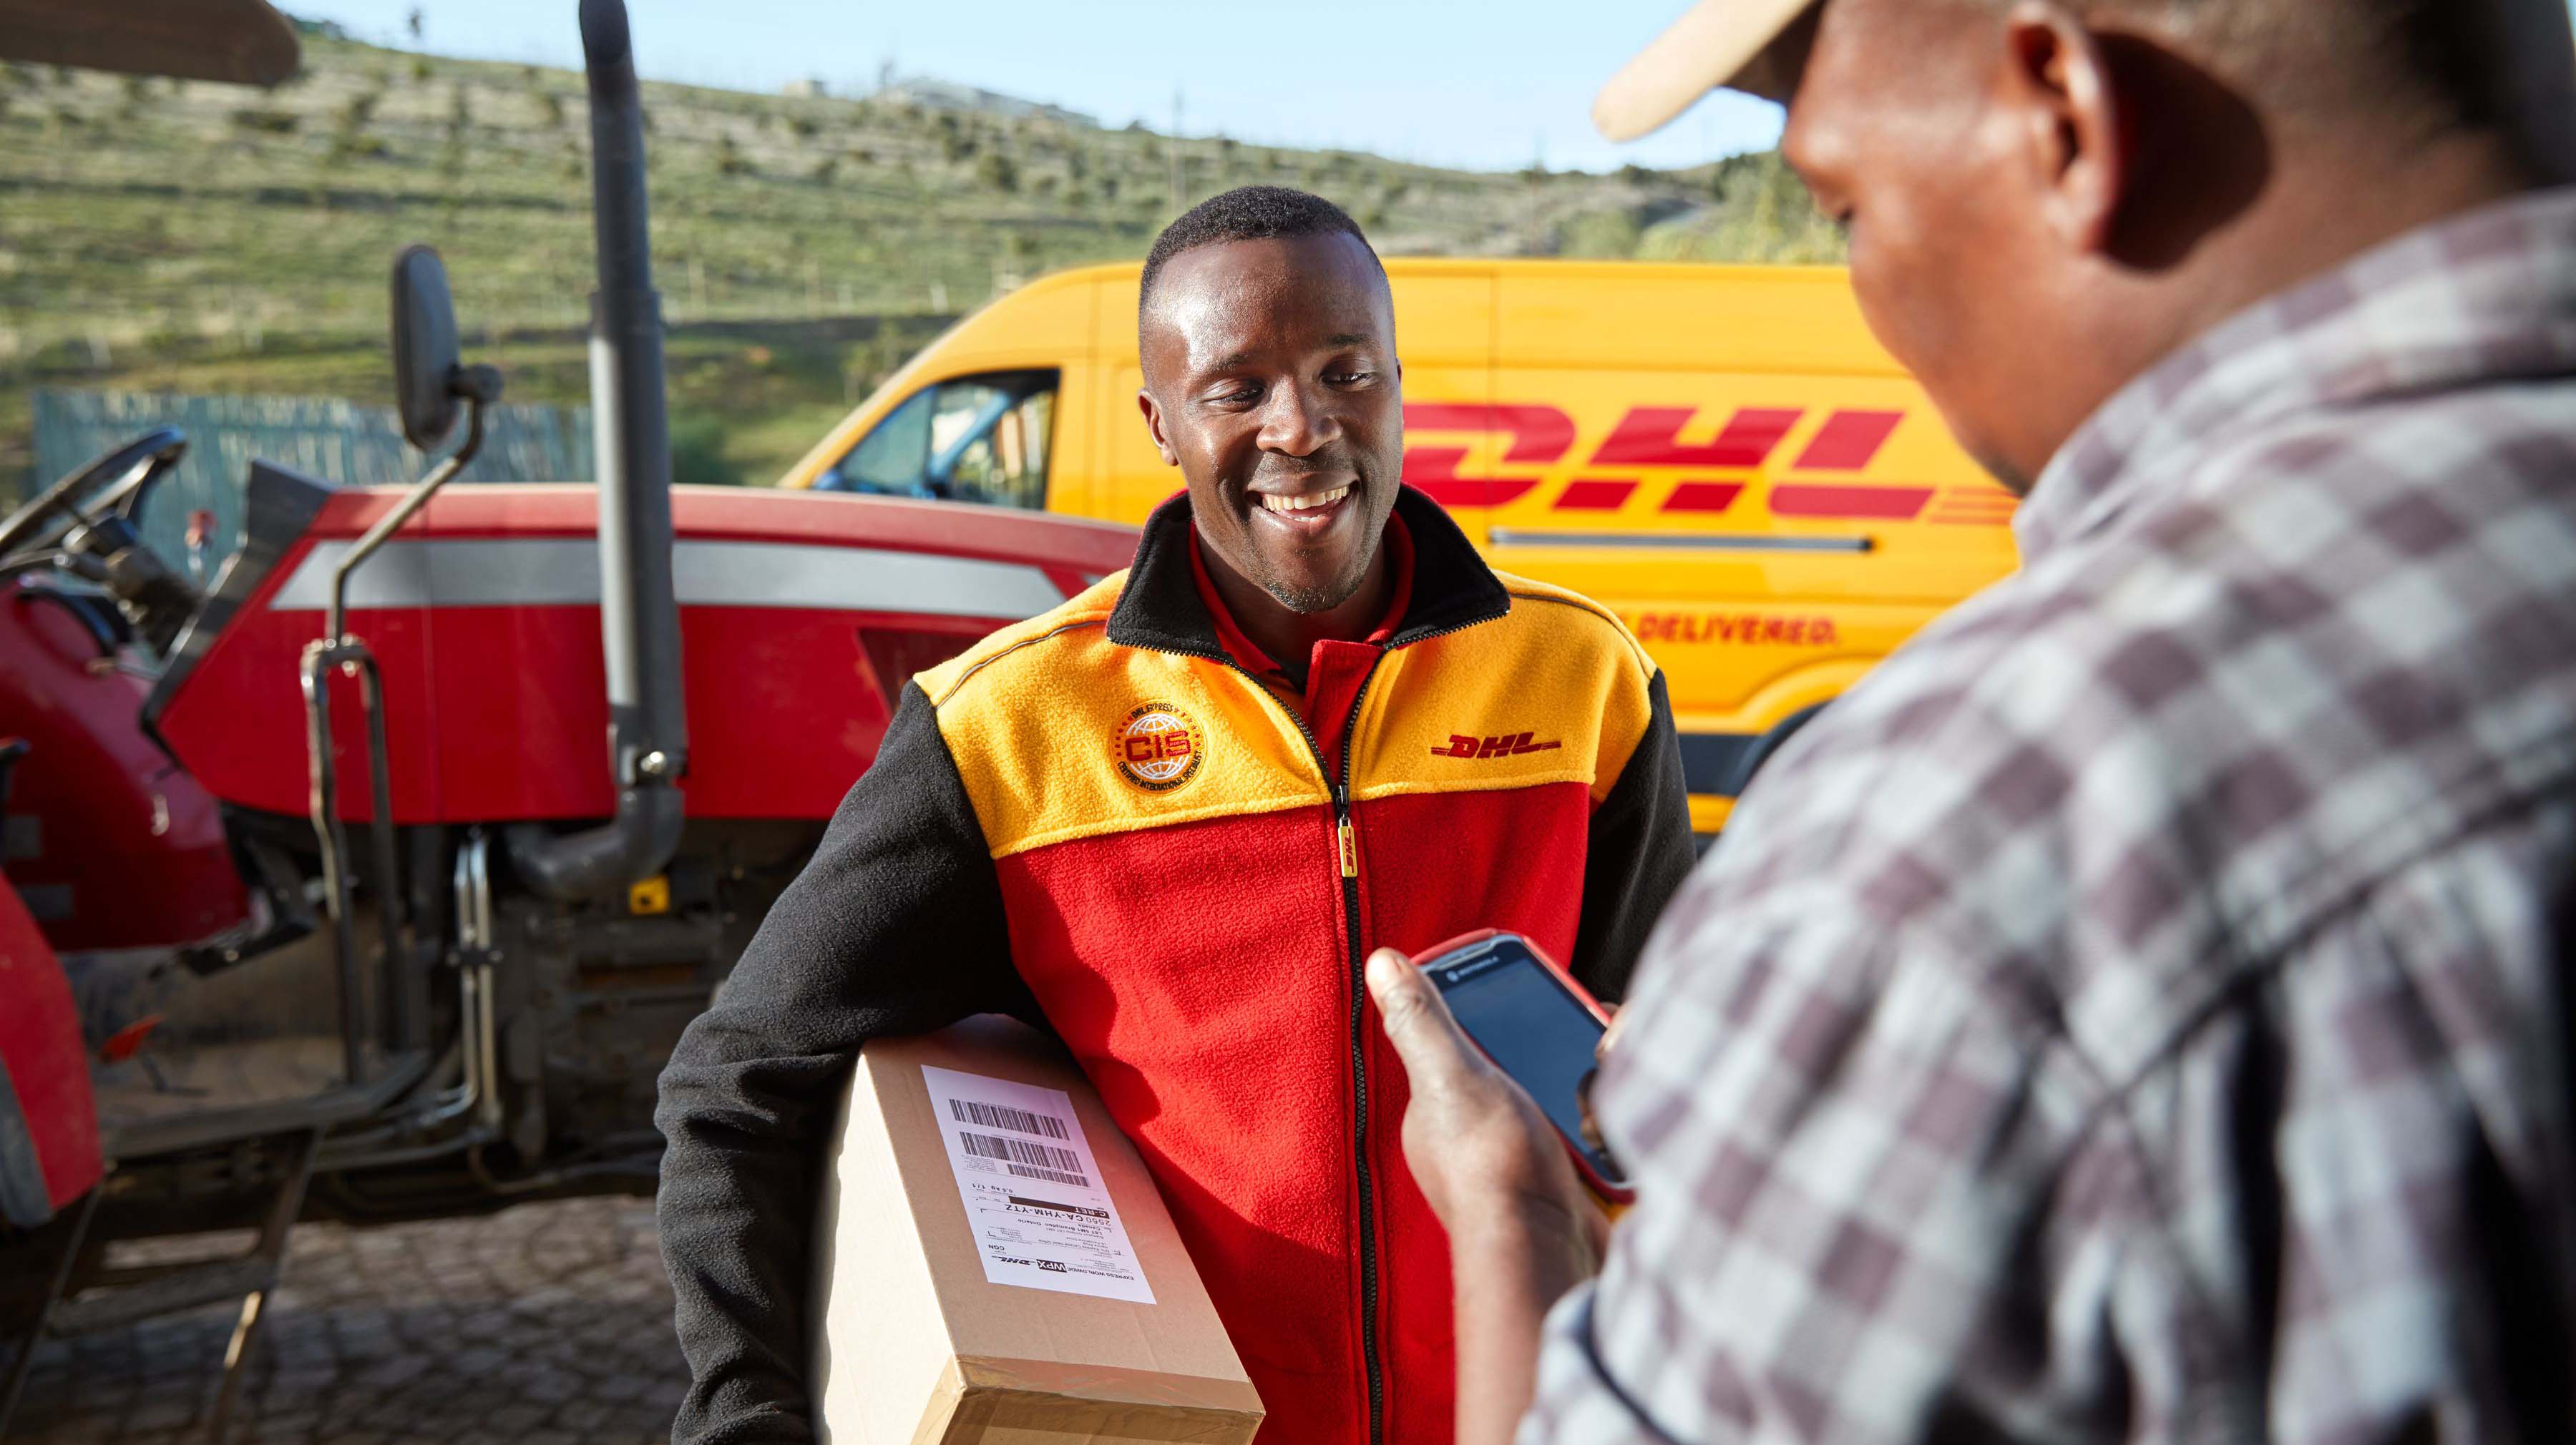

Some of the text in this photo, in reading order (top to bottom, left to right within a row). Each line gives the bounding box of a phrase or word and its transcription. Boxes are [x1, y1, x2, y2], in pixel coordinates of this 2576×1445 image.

[1401, 403, 1935, 519] DHL
[1125, 730, 1191, 762] CIS
[1431, 732, 1562, 759] DHL
[1344, 828, 1355, 873] DHL
[1004, 1204, 1111, 1226] 2550 CA-YHM-YTZ
[1075, 1207, 1106, 1217] C-RET
[992, 1255, 1036, 1265] DHL
[1037, 1260, 1066, 1272] WPX
[1067, 1267, 1106, 1276] WORLDWIDE
